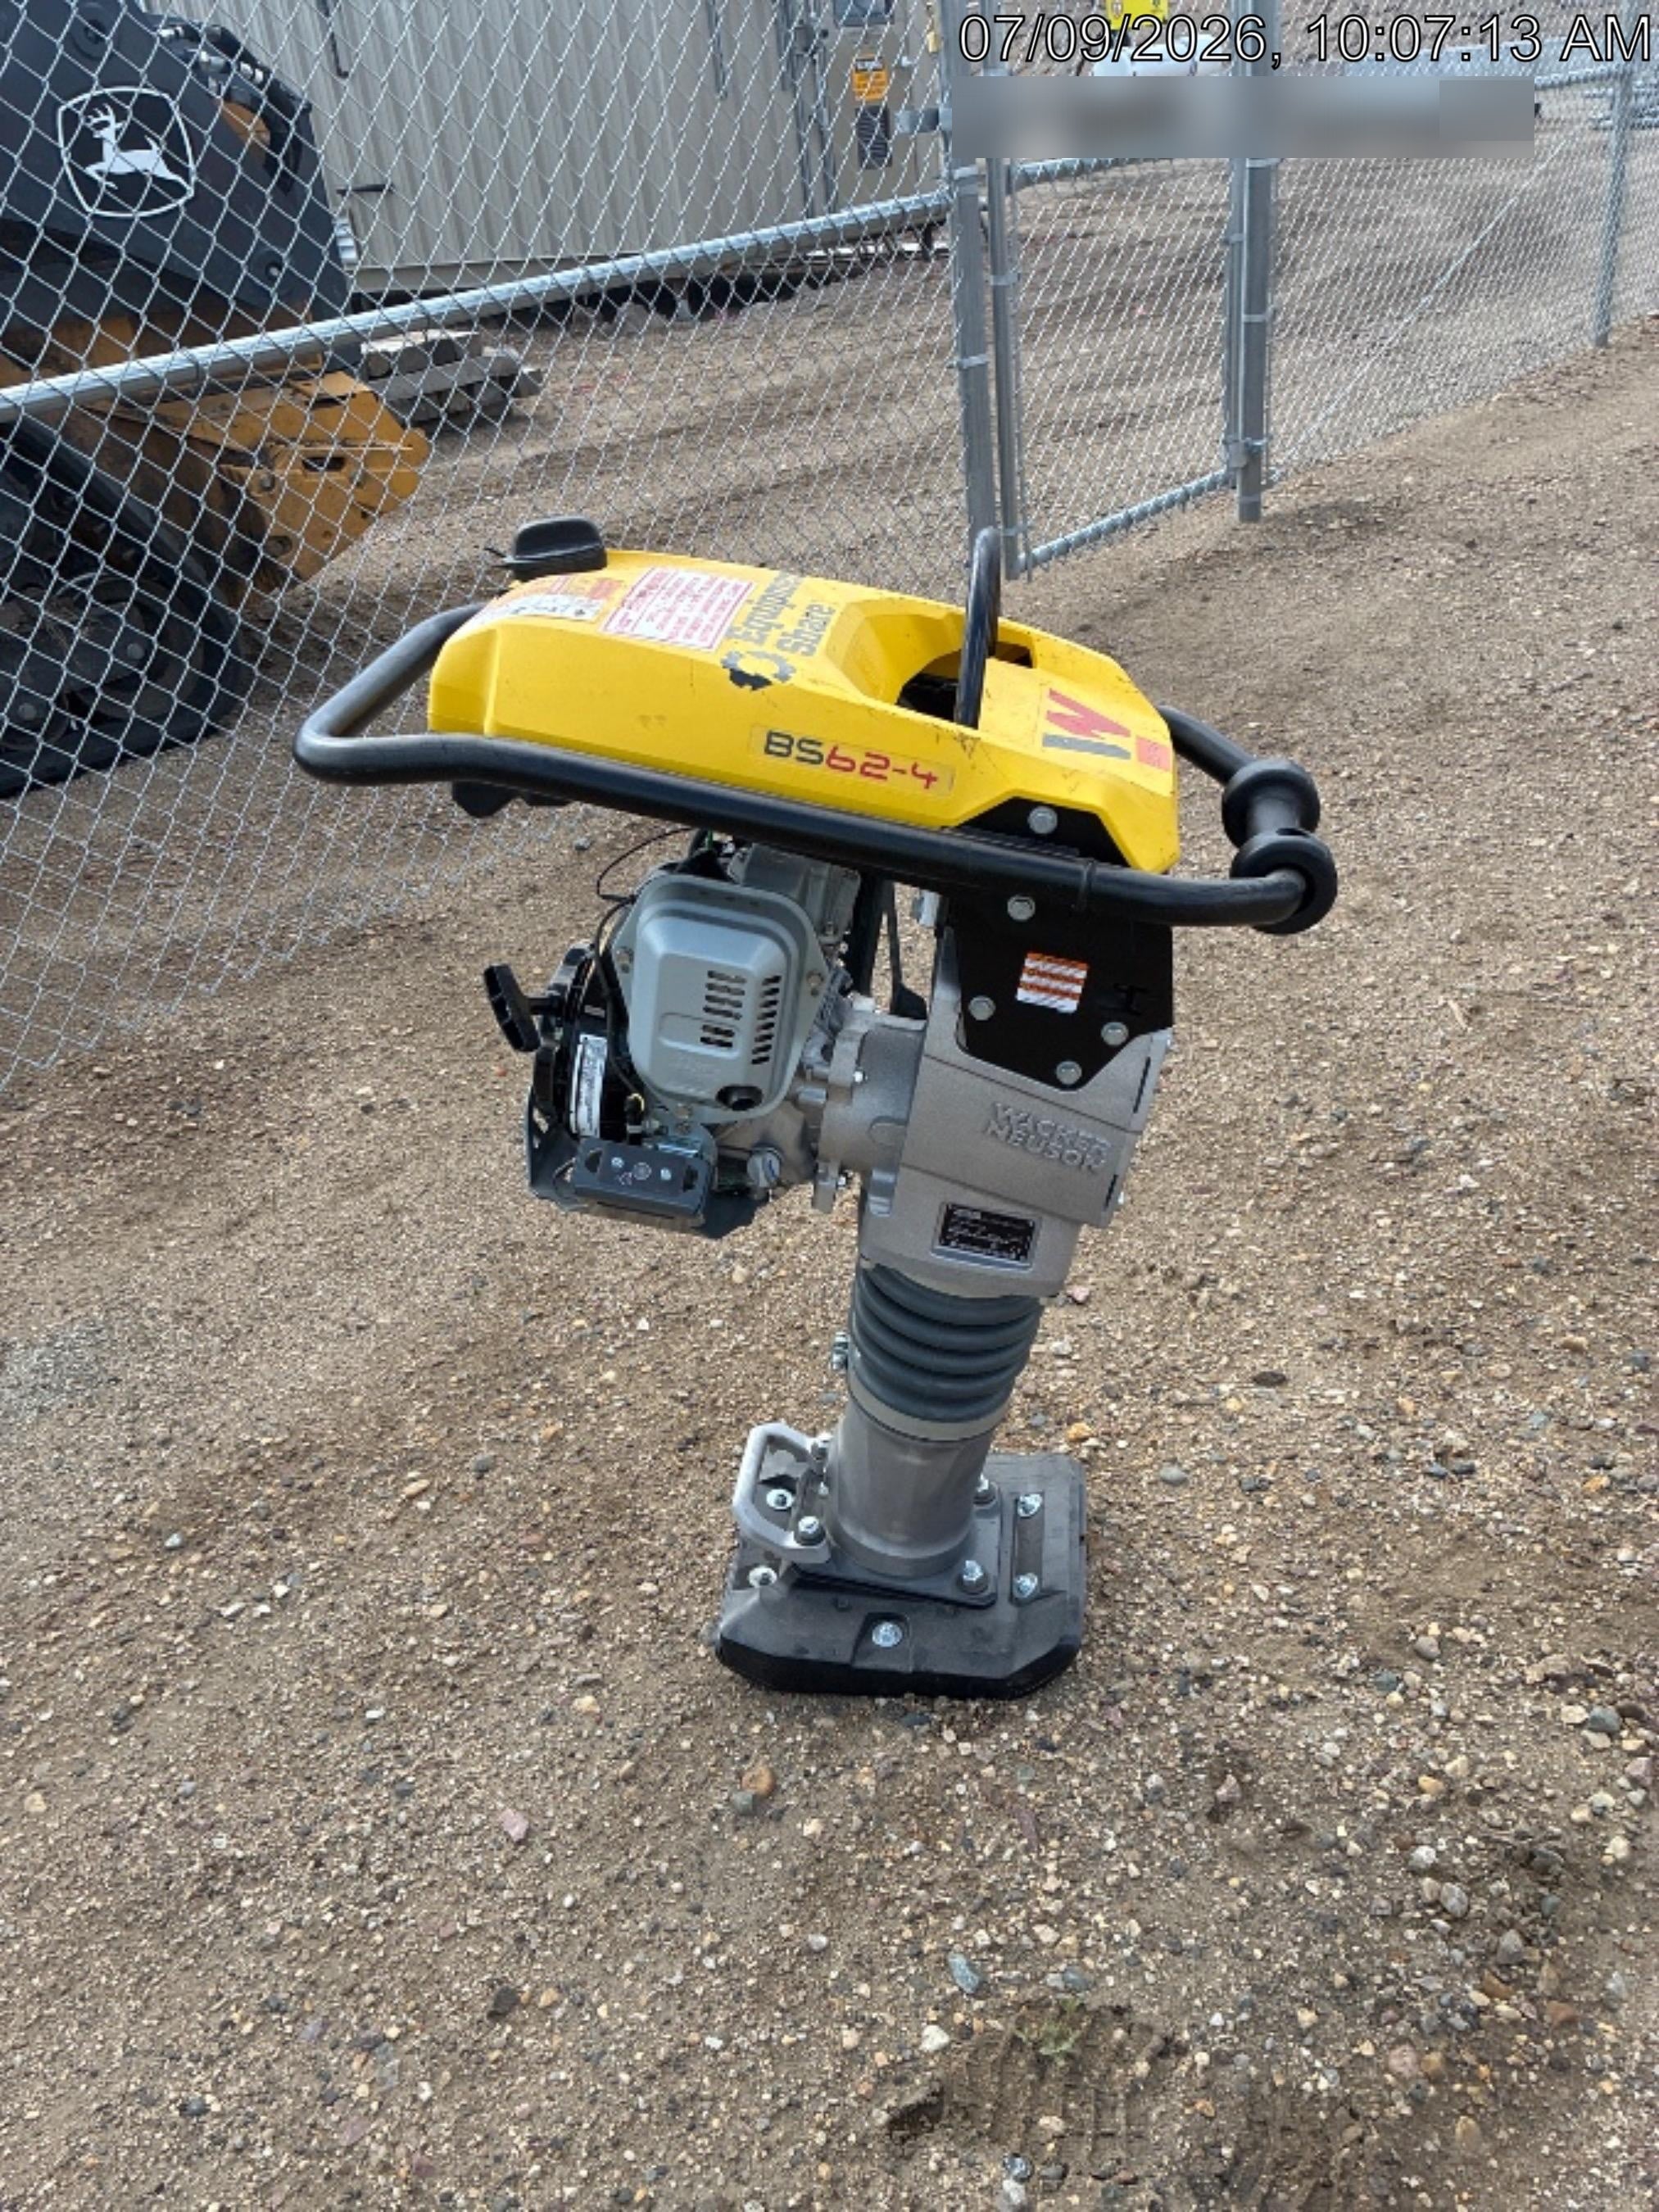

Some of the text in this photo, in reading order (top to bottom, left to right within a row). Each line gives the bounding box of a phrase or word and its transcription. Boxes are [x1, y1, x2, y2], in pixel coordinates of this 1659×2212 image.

[777, 604, 836, 656] Share
[764, 729, 939, 790] BS62-4
[994, 1102, 1112, 1158] WACKER
